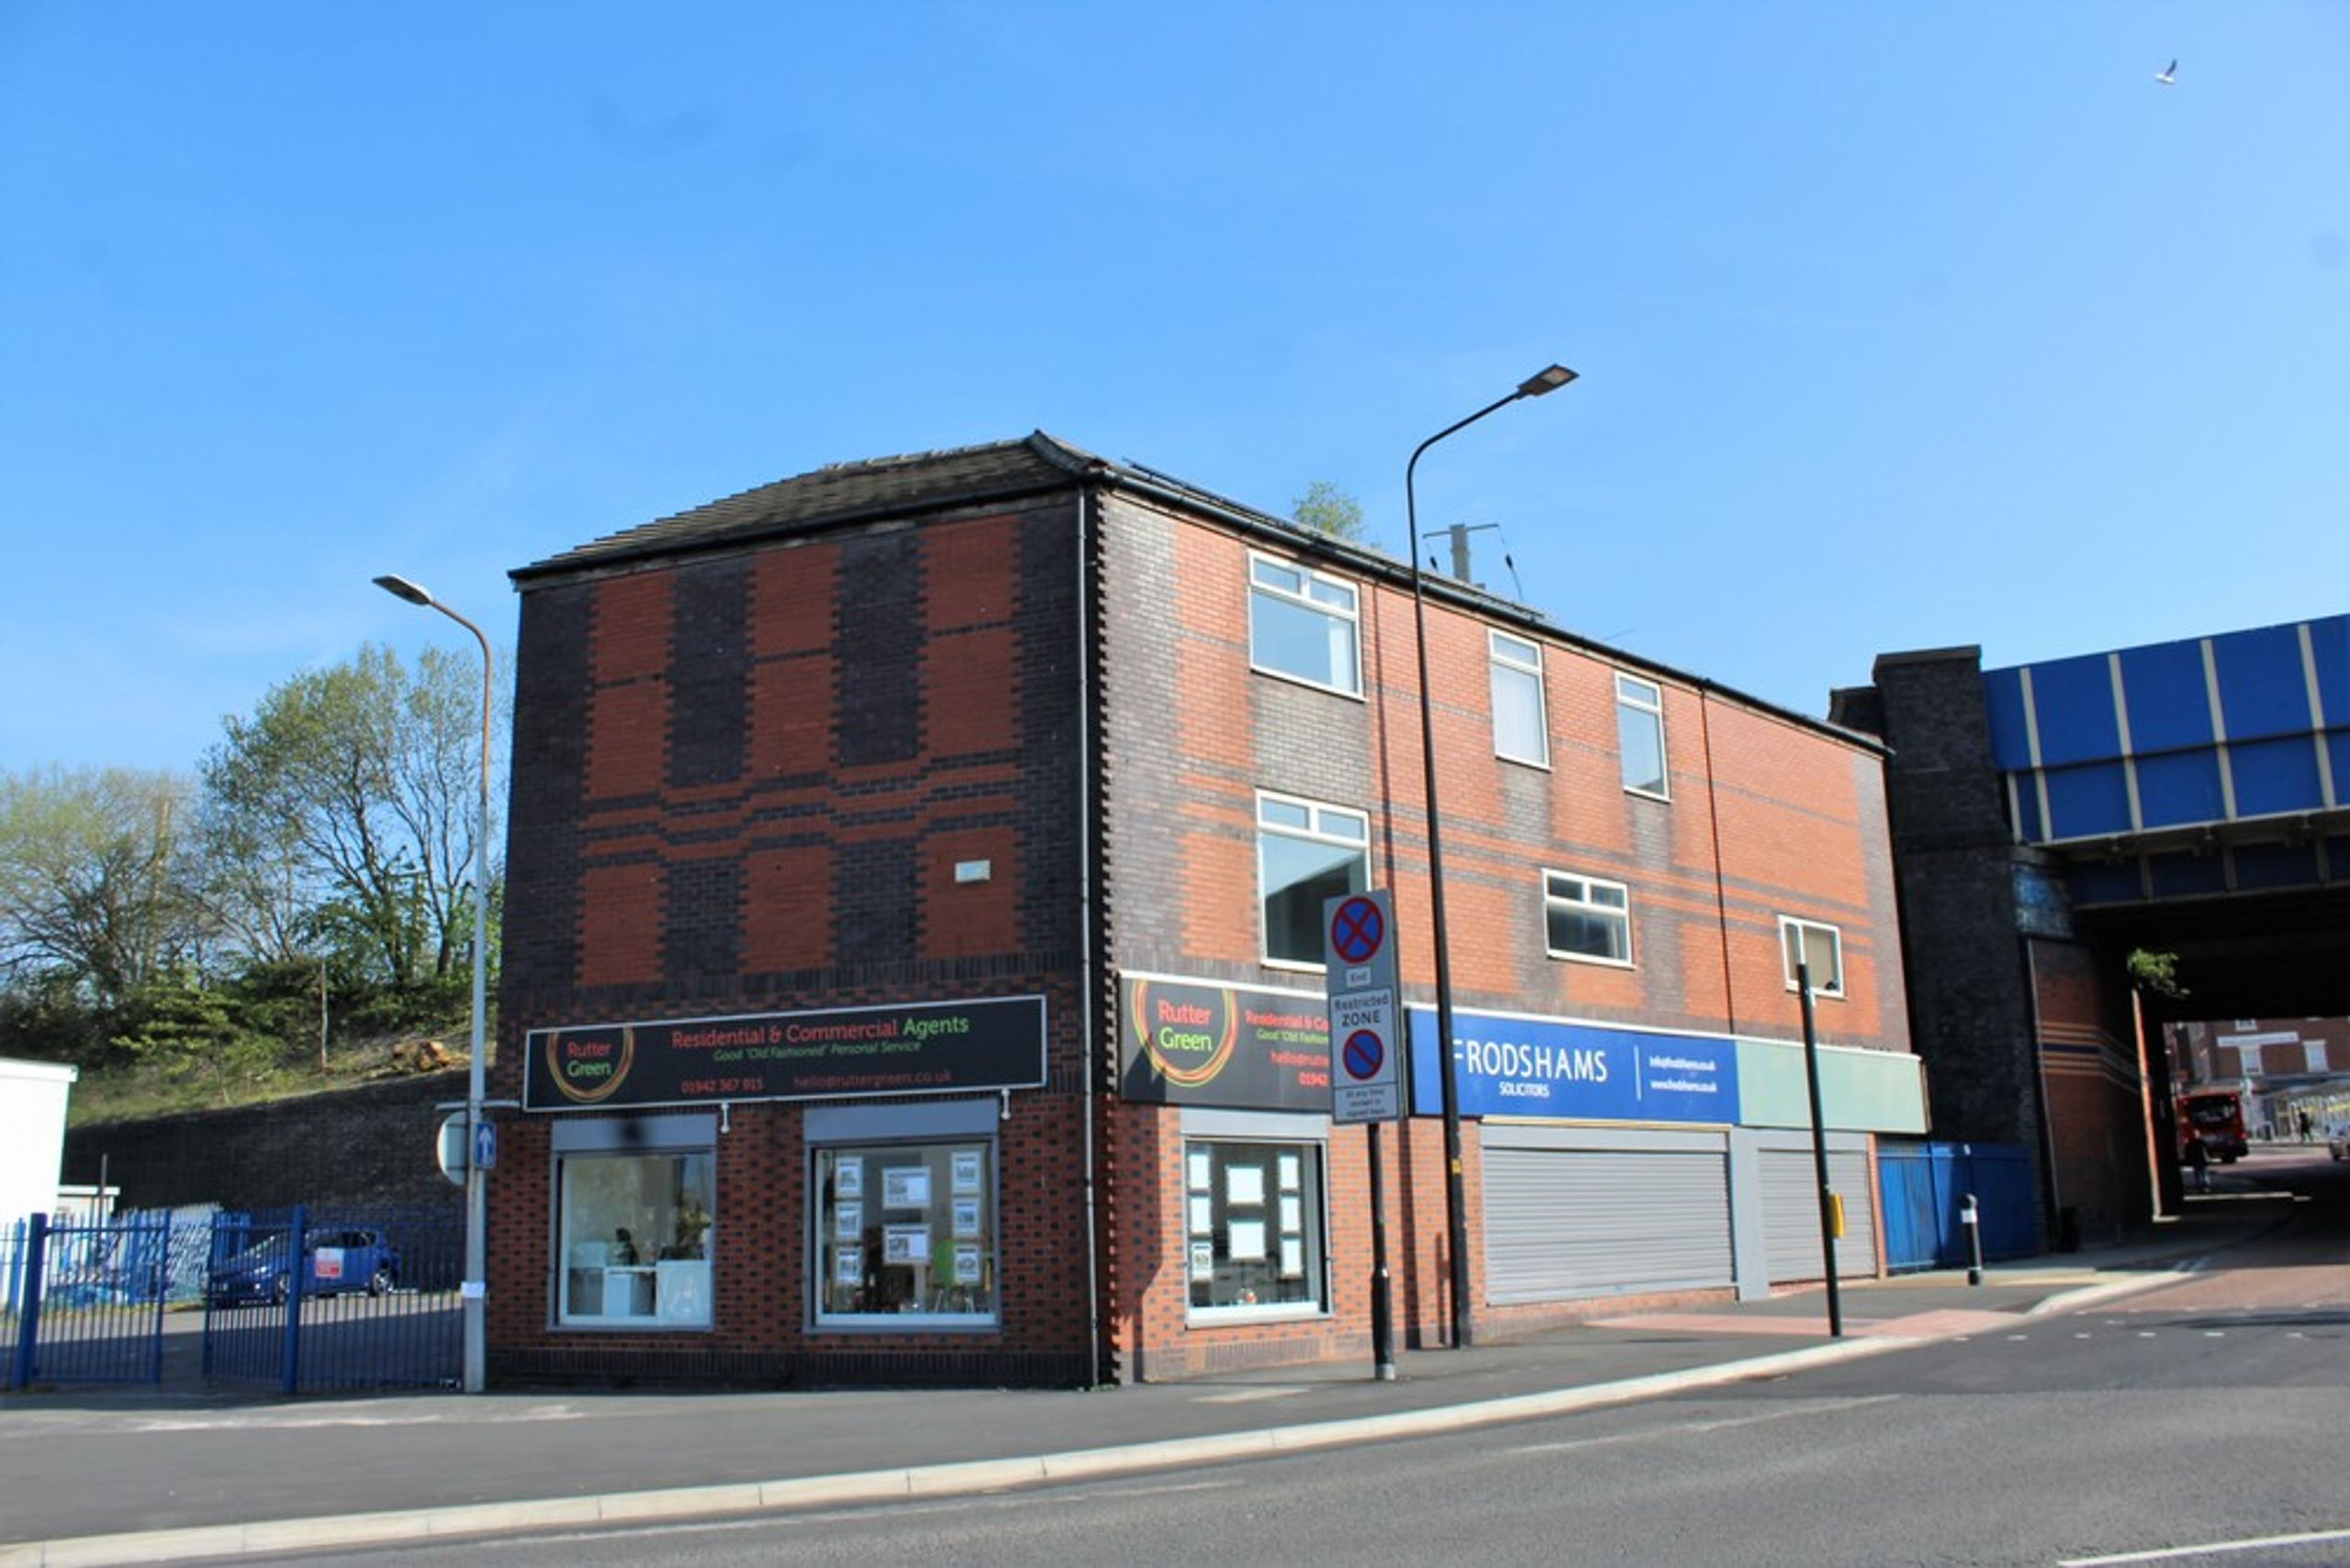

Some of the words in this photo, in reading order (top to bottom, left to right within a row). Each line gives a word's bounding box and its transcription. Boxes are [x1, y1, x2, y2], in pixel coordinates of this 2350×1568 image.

[1334, 992, 1390, 1011] Restricted
[1158, 998, 1211, 1025] Rutter
[1341, 1009, 1382, 1027] ZONE
[671, 1025, 766, 1049] Residential
[769, 1025, 780, 1043] &
[787, 1018, 898, 1043] Commercial
[902, 1014, 970, 1039] Agents
[1159, 1026, 1213, 1052] Green
[566, 1040, 611, 1058] Rutter
[713, 1047, 744, 1061] Good
[831, 1041, 878, 1056] Personal
[880, 1039, 923, 1054] Service
[566, 1059, 612, 1078] Green
[1498, 1081, 1550, 1099] SOLICITORS
